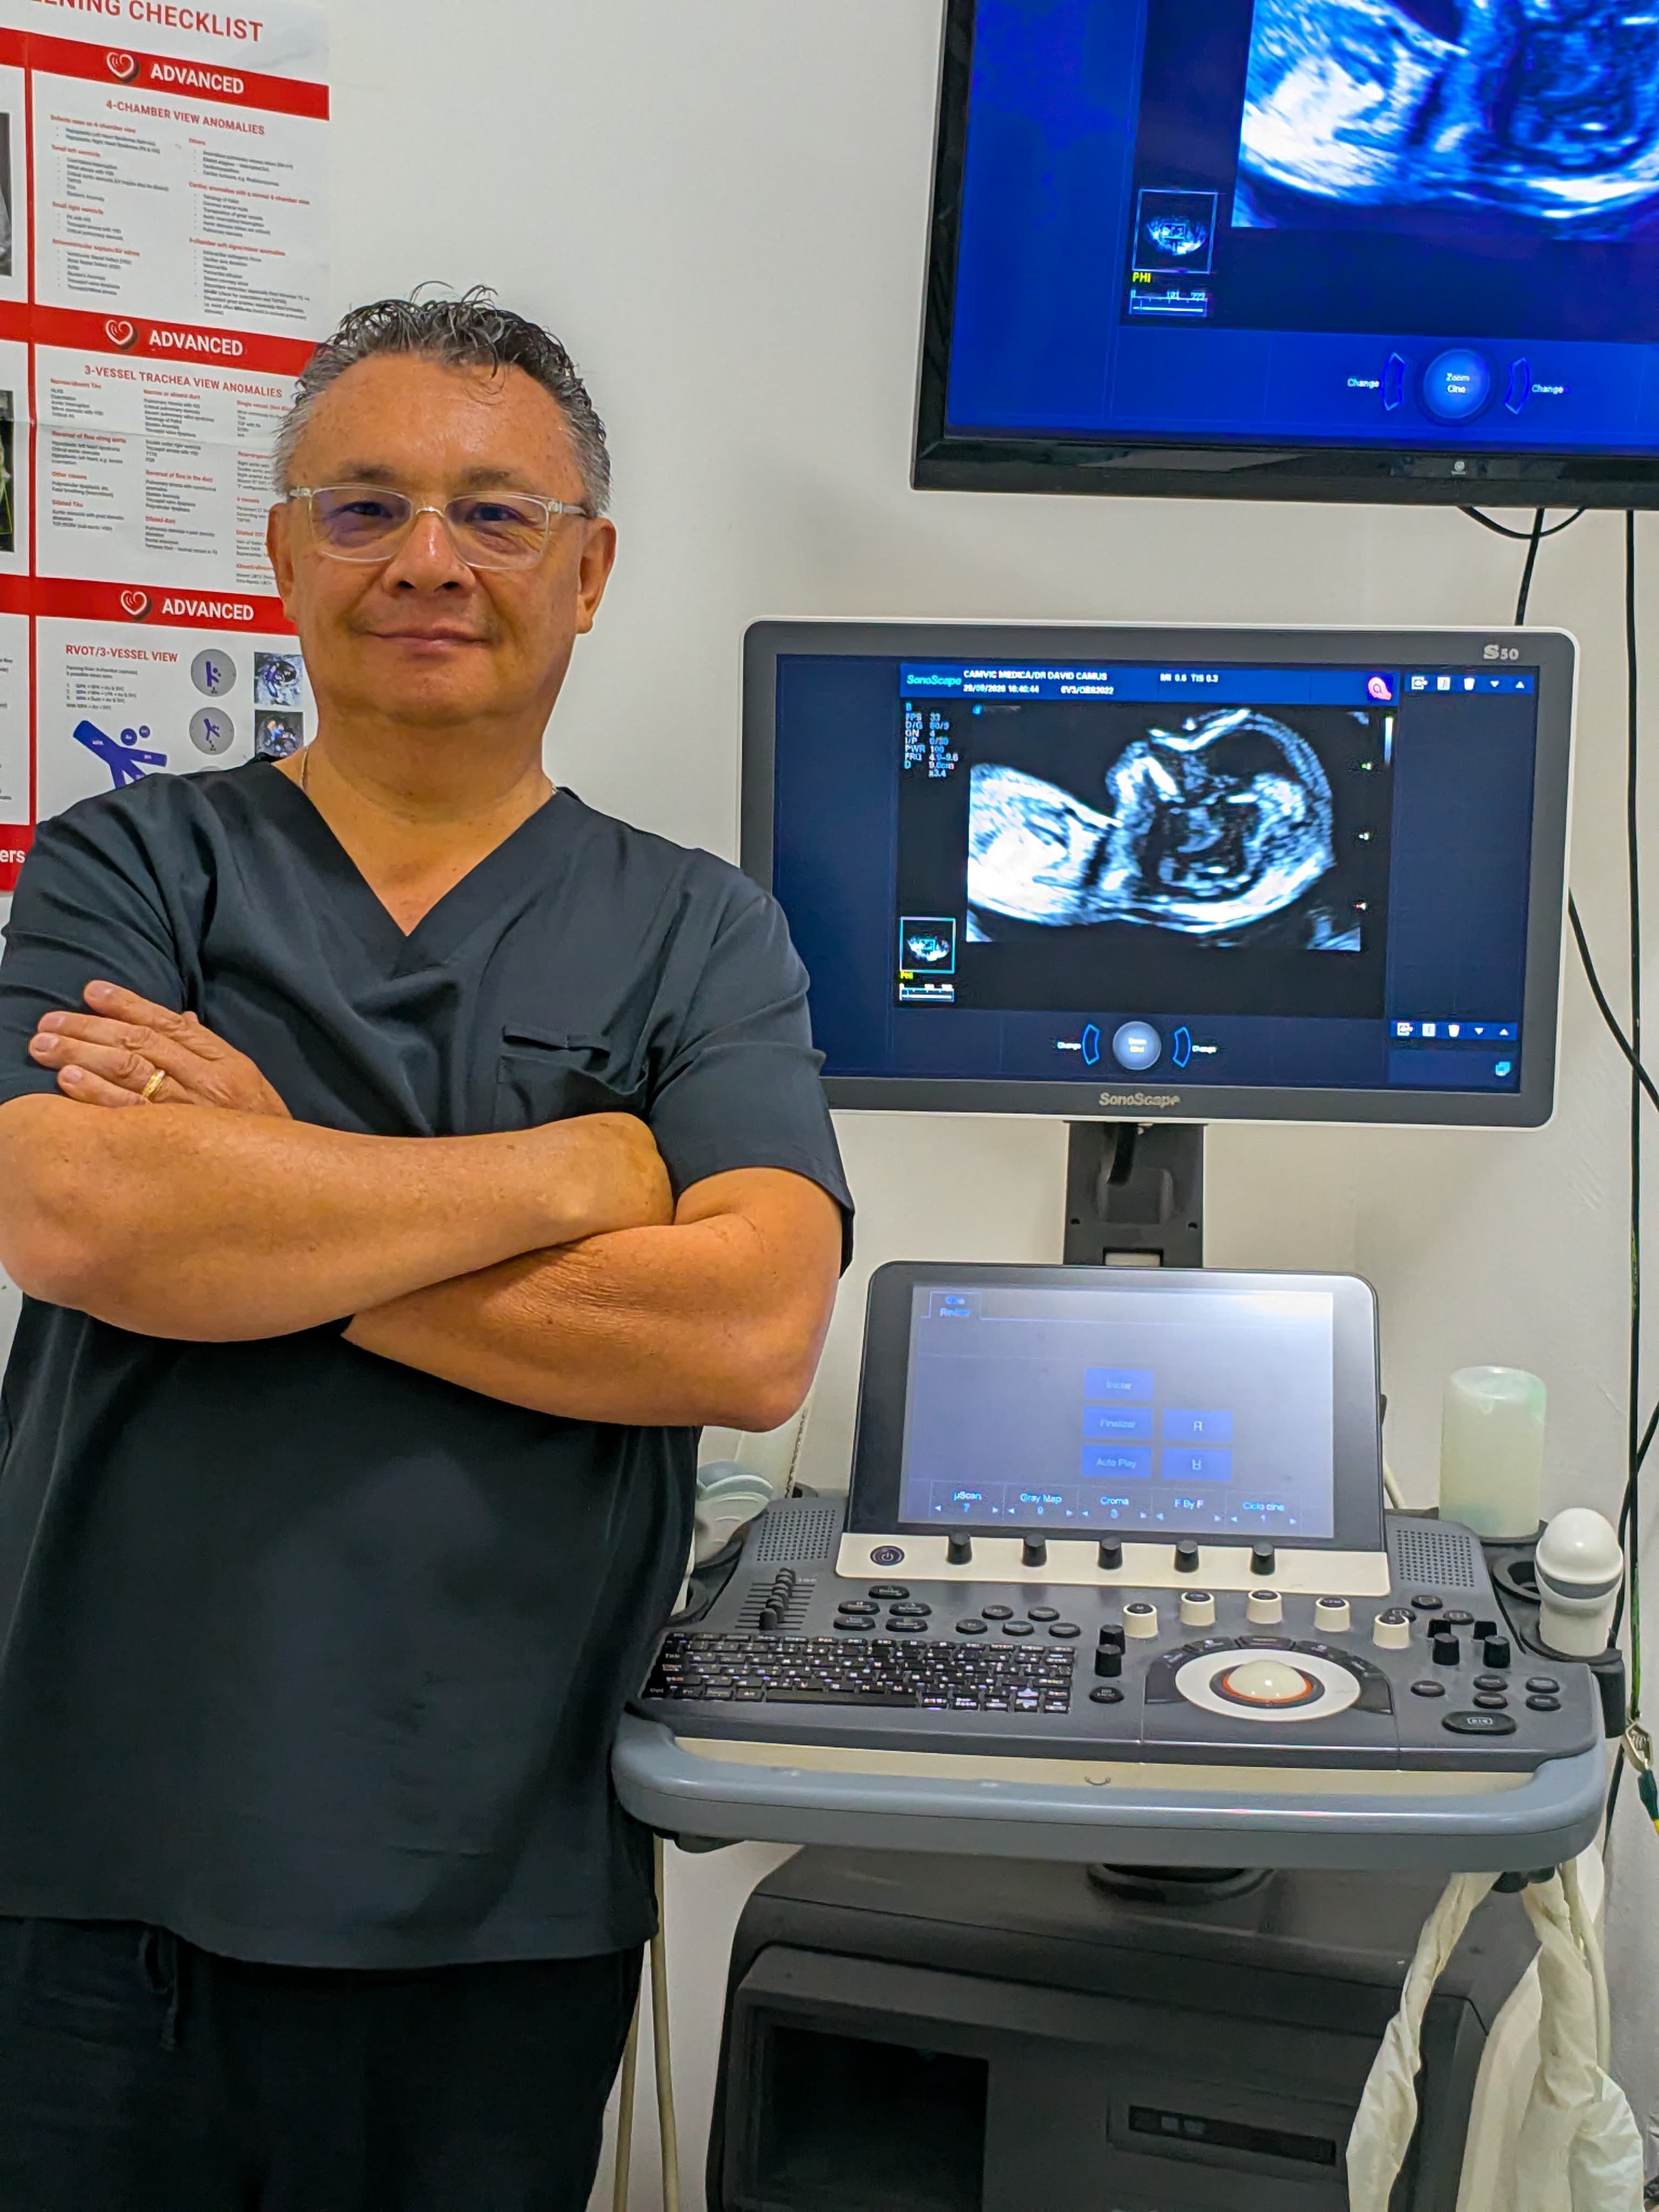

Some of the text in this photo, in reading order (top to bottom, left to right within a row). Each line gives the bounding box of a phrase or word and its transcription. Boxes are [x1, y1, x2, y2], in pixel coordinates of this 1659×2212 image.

[129, 1, 263, 42] CHECKLIST
[151, 64, 244, 94] ADVANCED
[106, 100, 265, 134] 4-CHAMBER VIEW ANOMALIES
[1132, 272, 1151, 283] PHI
[149, 331, 243, 356] ADVANCED
[84, 365, 282, 398] 3-VESSEL TRACHEA VIEW ANOMALIES
[1347, 373, 1564, 394] Change Zoom Change
[162, 598, 254, 621] ADVANCED
[151, 651, 178, 662] VIEW
[1483, 644, 1519, 660] S50
[907, 675, 962, 687] SonoScape
[1048, 671, 1074, 680] DAVID
[905, 745, 926, 753] PWR
[1099, 1092, 1181, 1109] SonoScape
[1096, 1457, 1137, 1469] Auto Play
[1020, 1493, 1041, 1503] Gray
[1100, 1496, 1129, 1505] Croma
[1175, 1499, 1181, 1507] F
[1183, 1499, 1195, 1510] By
